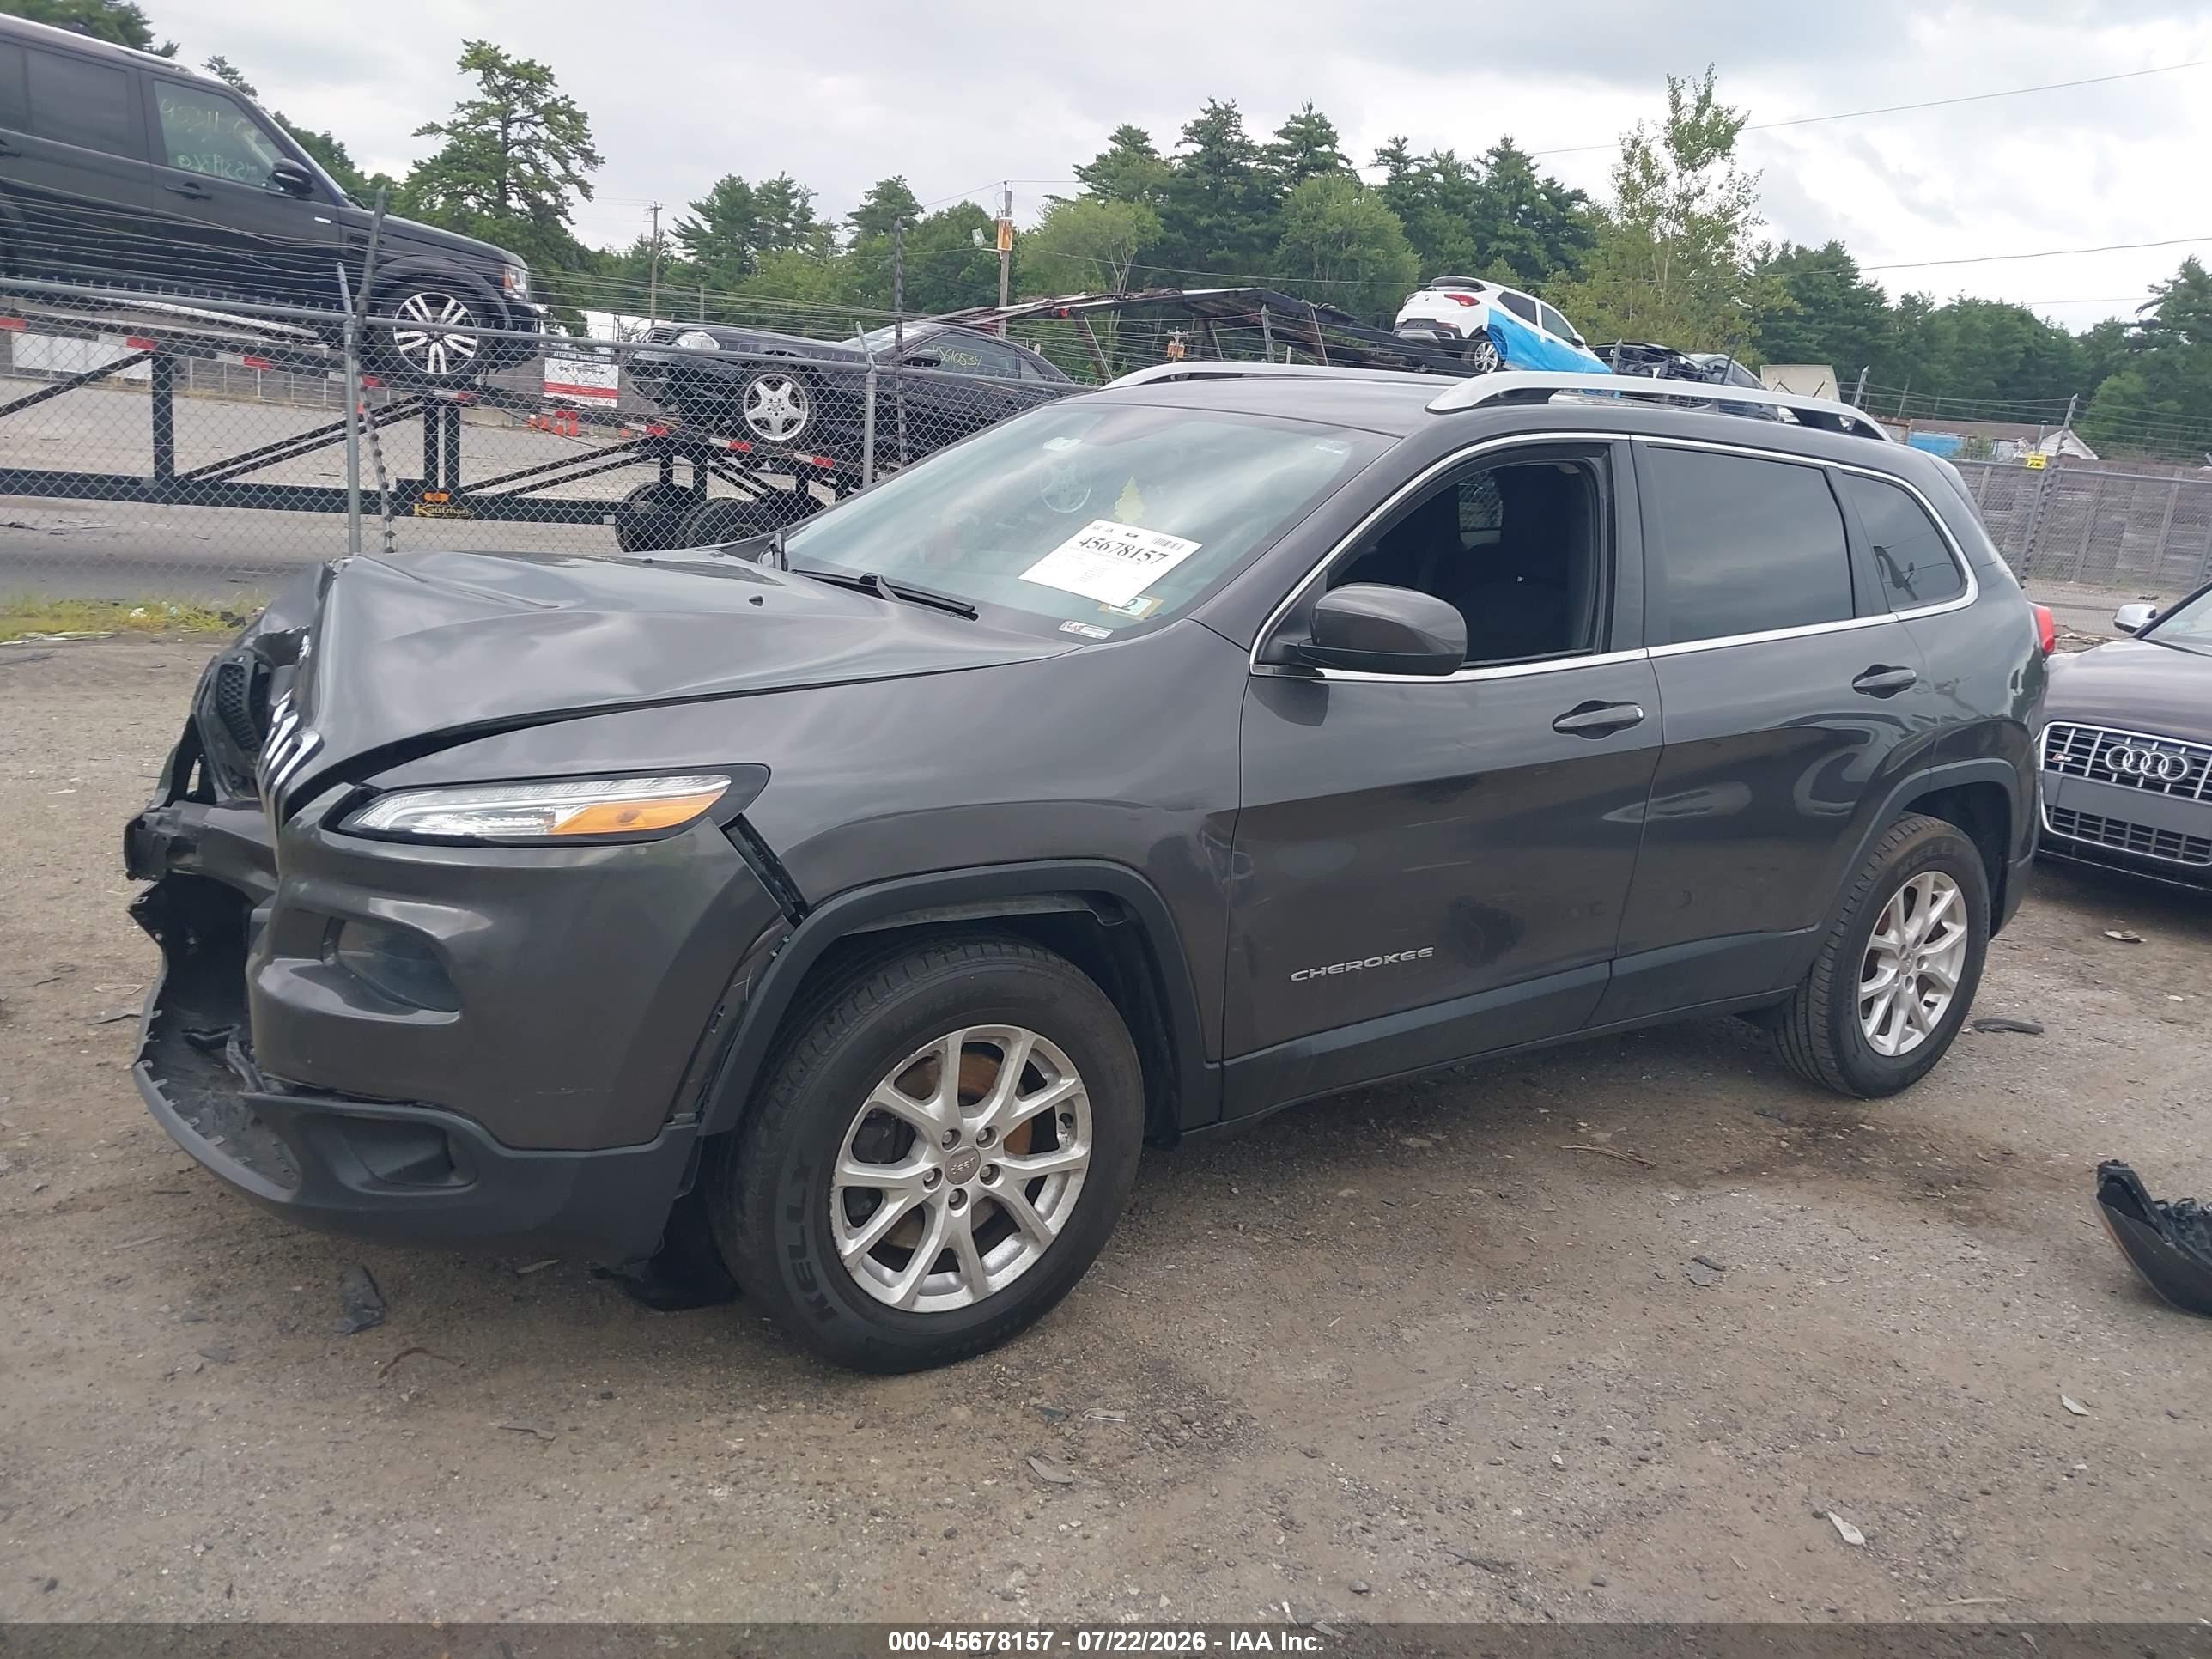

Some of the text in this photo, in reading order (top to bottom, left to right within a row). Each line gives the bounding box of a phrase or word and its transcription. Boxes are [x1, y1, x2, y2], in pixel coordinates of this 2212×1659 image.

[413, 503, 470, 517] Kaufman
[1079, 536, 1169, 564] 45678157
[1291, 946, 1434, 981] CHEROKEE
[951, 1156, 976, 1175] Jeep
[787, 1146, 839, 1322] KELLY
